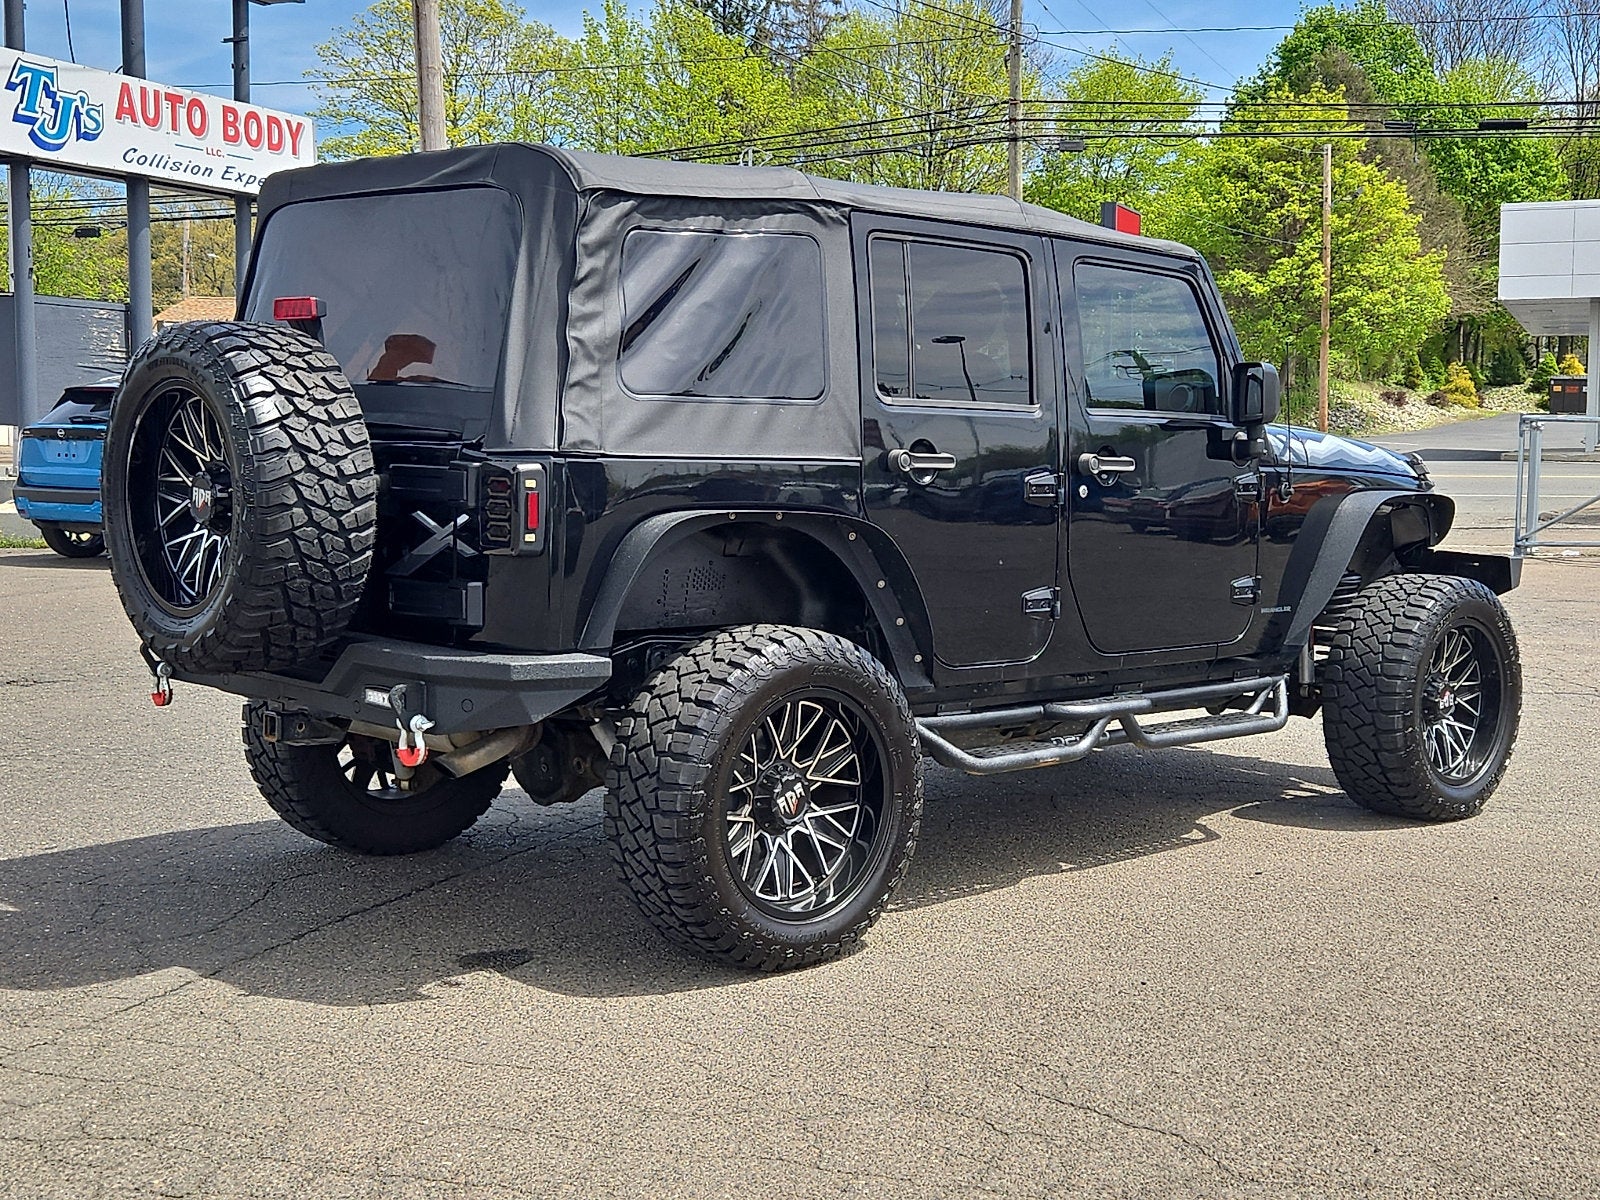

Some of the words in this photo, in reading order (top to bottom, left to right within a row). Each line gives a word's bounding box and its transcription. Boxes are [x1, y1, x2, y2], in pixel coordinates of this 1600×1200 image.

[5, 57, 104, 151] TJ's
[115, 82, 208, 138] AUTO
[222, 104, 304, 157] BODY
[122, 147, 214, 178] Collision
[205, 146, 225, 158] LLC.
